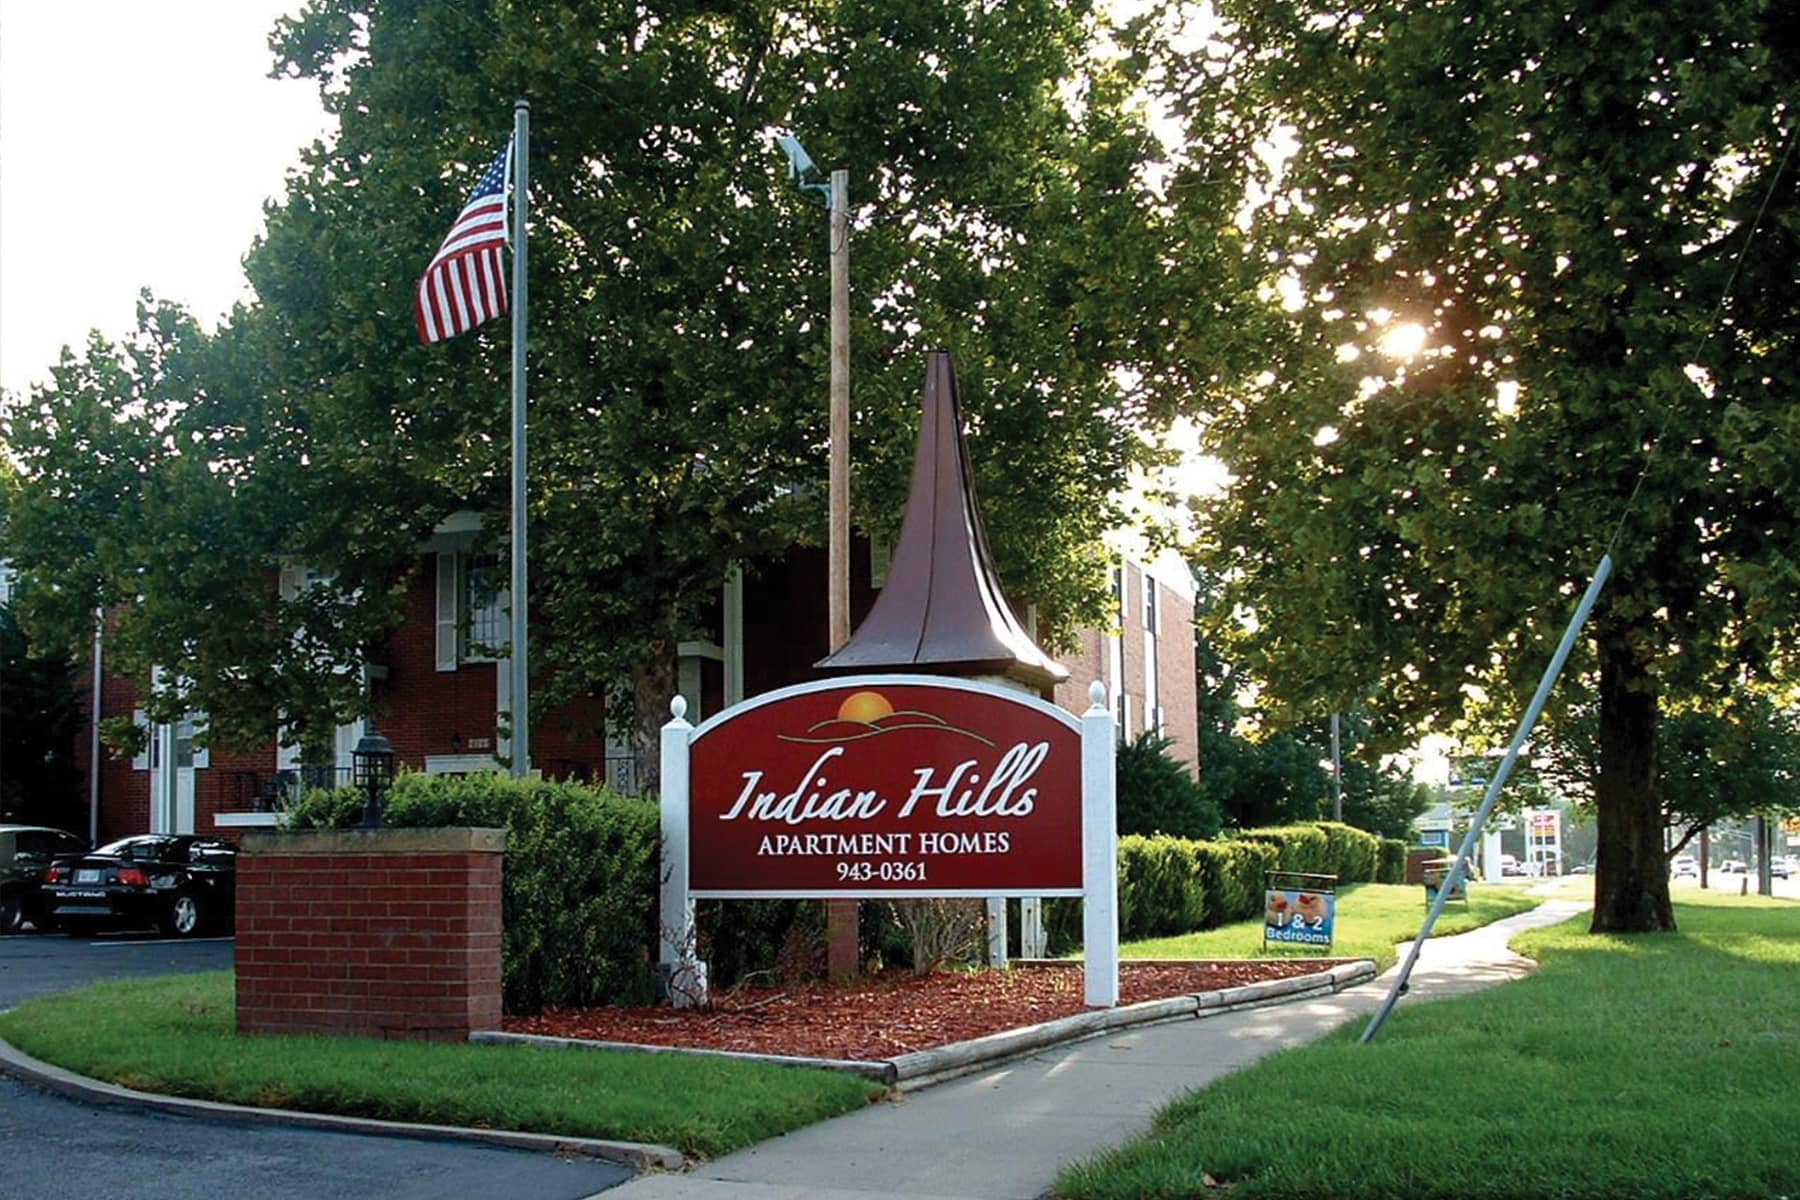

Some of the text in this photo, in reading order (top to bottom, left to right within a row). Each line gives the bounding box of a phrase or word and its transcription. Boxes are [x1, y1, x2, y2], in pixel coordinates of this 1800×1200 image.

[719, 741, 1050, 825] Indian Hills
[757, 831, 1010, 856] APARTMENT HOMES
[836, 861, 927, 882] 943-0361
[1276, 912, 1323, 931] 1 & 2
[1266, 927, 1330, 943] Bedrooms
